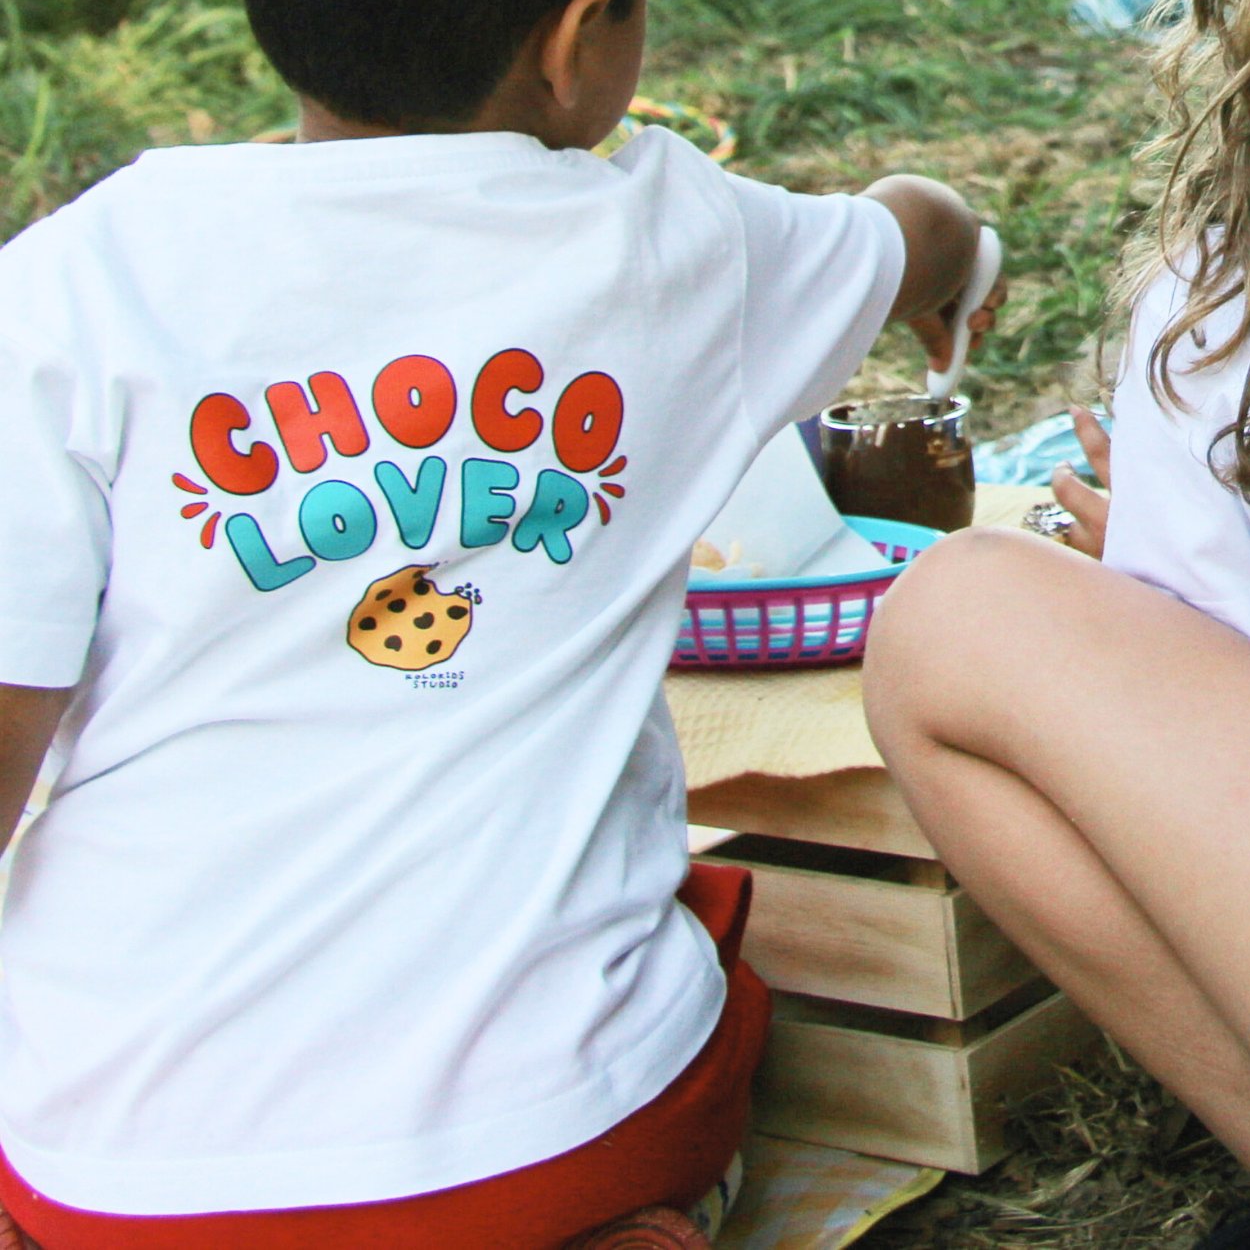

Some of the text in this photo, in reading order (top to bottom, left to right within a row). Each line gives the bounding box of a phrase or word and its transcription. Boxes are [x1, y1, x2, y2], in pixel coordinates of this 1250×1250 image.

[189, 347, 624, 496] CHOCO
[225, 455, 590, 592] LOVER
[413, 679, 458, 689] STUDIO
